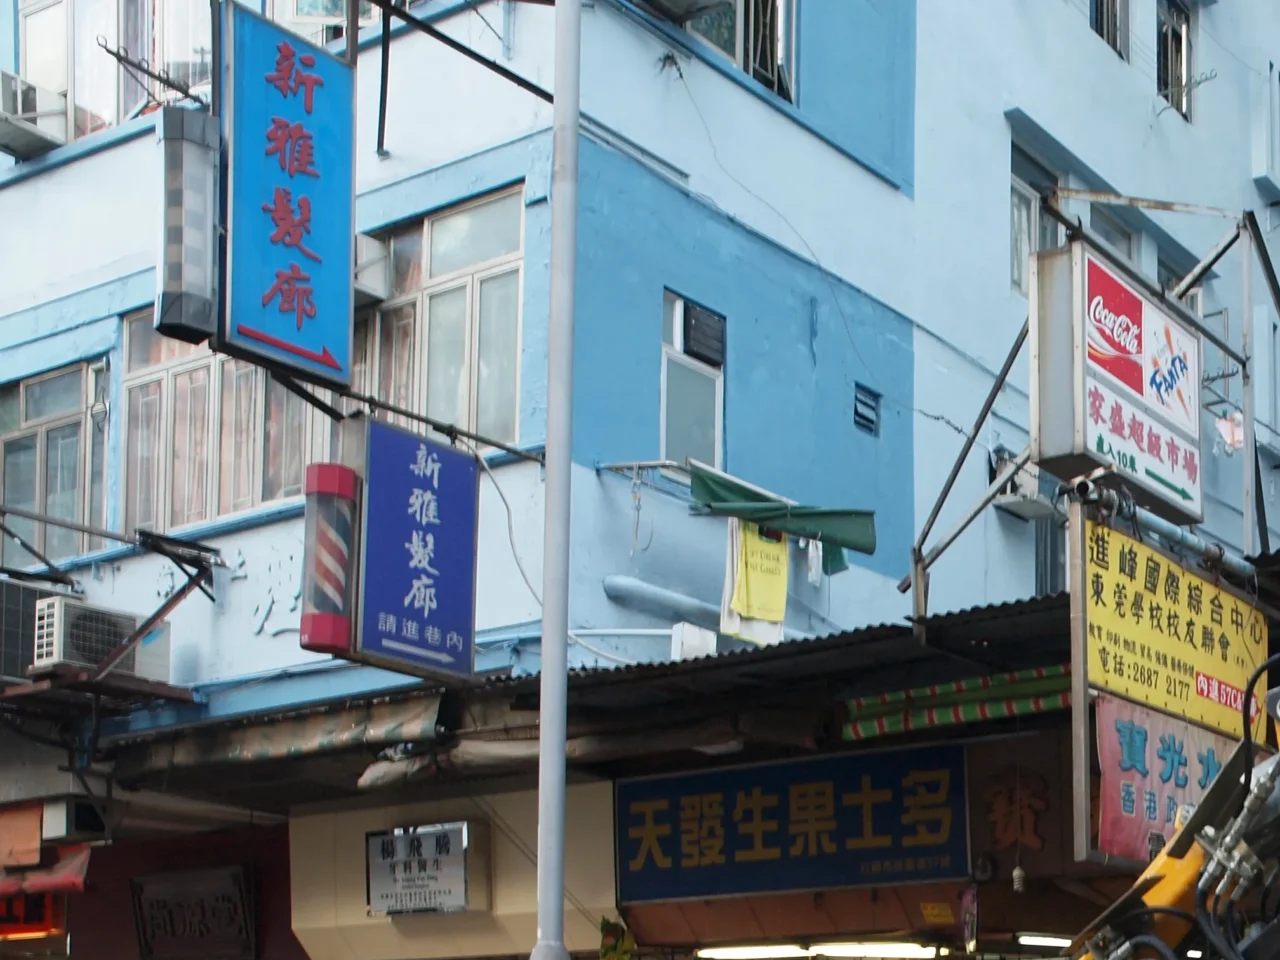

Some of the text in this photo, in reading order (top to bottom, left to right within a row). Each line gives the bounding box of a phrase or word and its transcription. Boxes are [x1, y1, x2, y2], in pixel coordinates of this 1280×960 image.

[262, 41, 324, 330] 新雅髮廊
[1087, 384, 1199, 485] 家盛超級市場
[403, 442, 442, 619] 新雅髮廊
[1088, 527, 1264, 645] 進峰國際綜合中心
[1090, 572, 1232, 665] 東莞學校校友聯會
[1165, 674, 1191, 702] 2177
[628, 768, 952, 872] 天發生果士多
